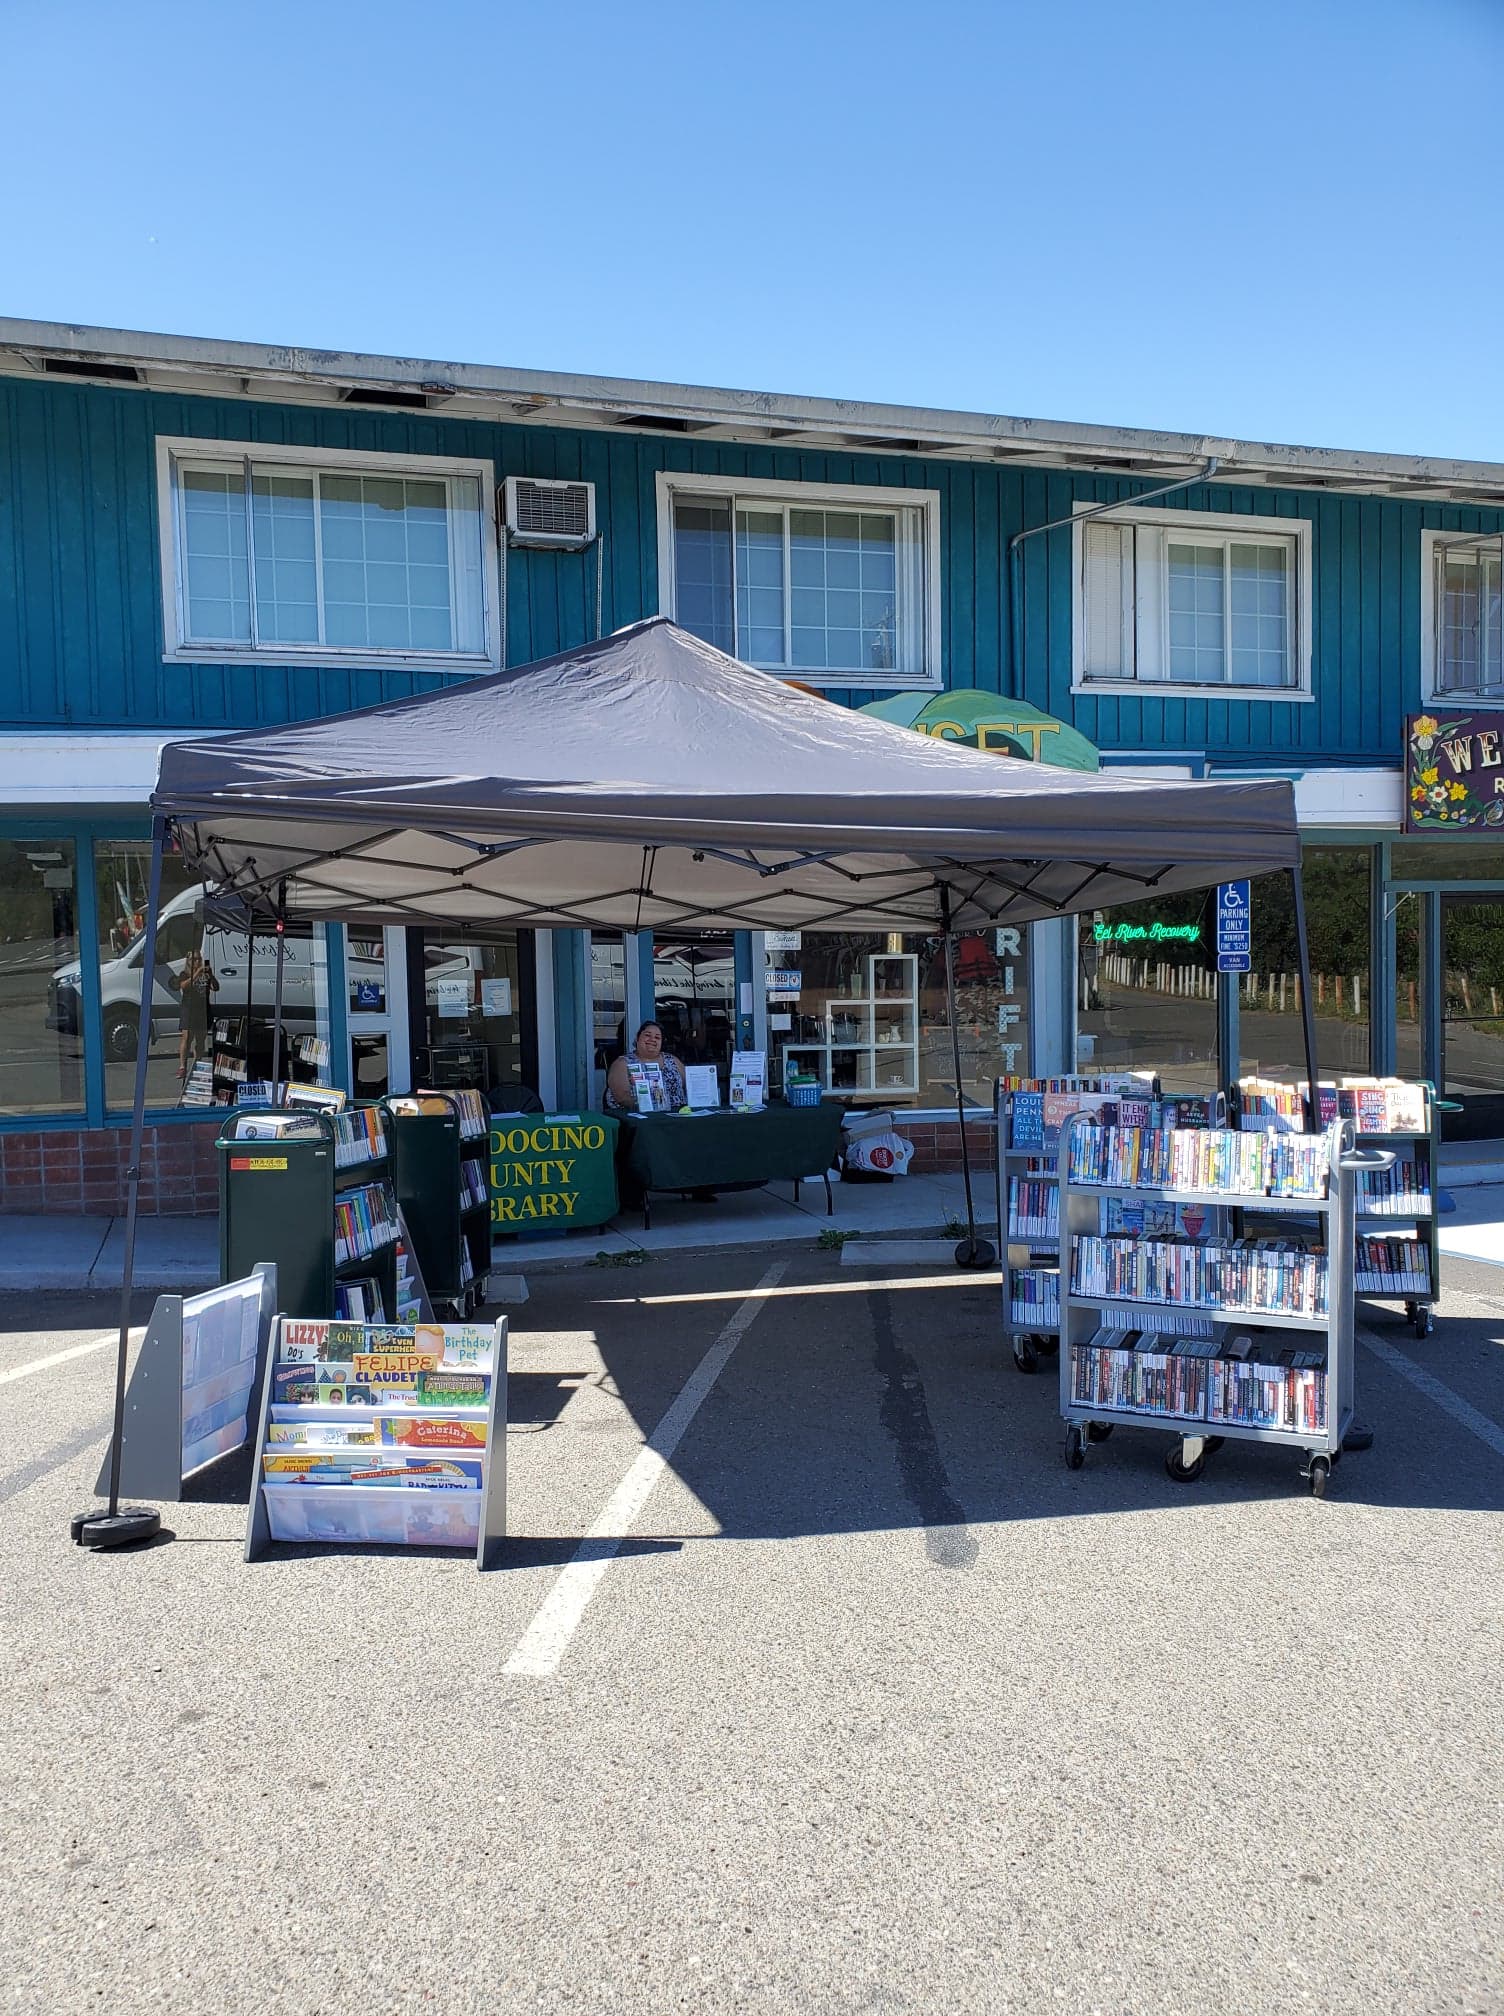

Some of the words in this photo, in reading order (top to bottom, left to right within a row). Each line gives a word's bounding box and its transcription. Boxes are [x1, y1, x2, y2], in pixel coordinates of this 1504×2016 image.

[1219, 908, 1249, 919] PARKING
[1225, 920, 1244, 931] ONLY
[1095, 923, 1113, 941] Eel
[1115, 923, 1148, 944] River
[1149, 922, 1200, 942] Recovery
[1223, 933, 1246, 942] MINIMUM
[765, 973, 788, 984] CLOSED
[238, 1085, 267, 1097] CLOSED
[1361, 1092, 1385, 1101] SING
[1122, 1103, 1130, 1113] IT
[1363, 1106, 1386, 1116] SING
[490, 1126, 605, 1155] DOCINO
[490, 1160, 577, 1188] UNTY
[461, 1328, 477, 1336] The
[445, 1336, 493, 1351] Birthday
[459, 1350, 478, 1361] Pet
[354, 1356, 434, 1372] FELIPE
[387, 1393, 401, 1401] The
[416, 1424, 468, 1440] Caterina
